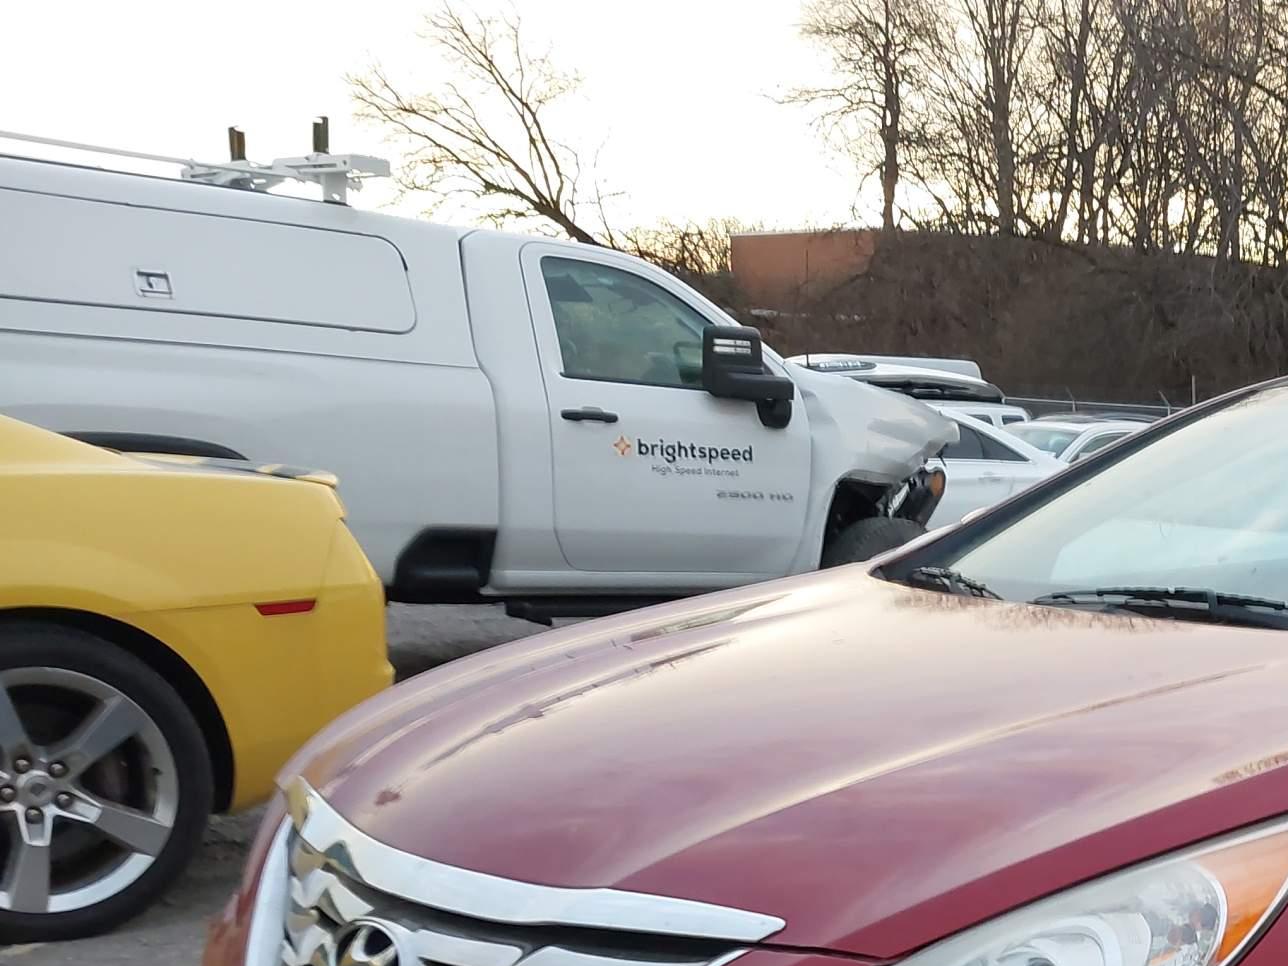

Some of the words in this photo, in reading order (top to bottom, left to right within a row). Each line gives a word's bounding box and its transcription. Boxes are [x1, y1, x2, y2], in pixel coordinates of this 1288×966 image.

[637, 438, 753, 464] brightspeed
[651, 464, 673, 476] High
[675, 466, 701, 477] Speed
[704, 467, 739, 477] Internet
